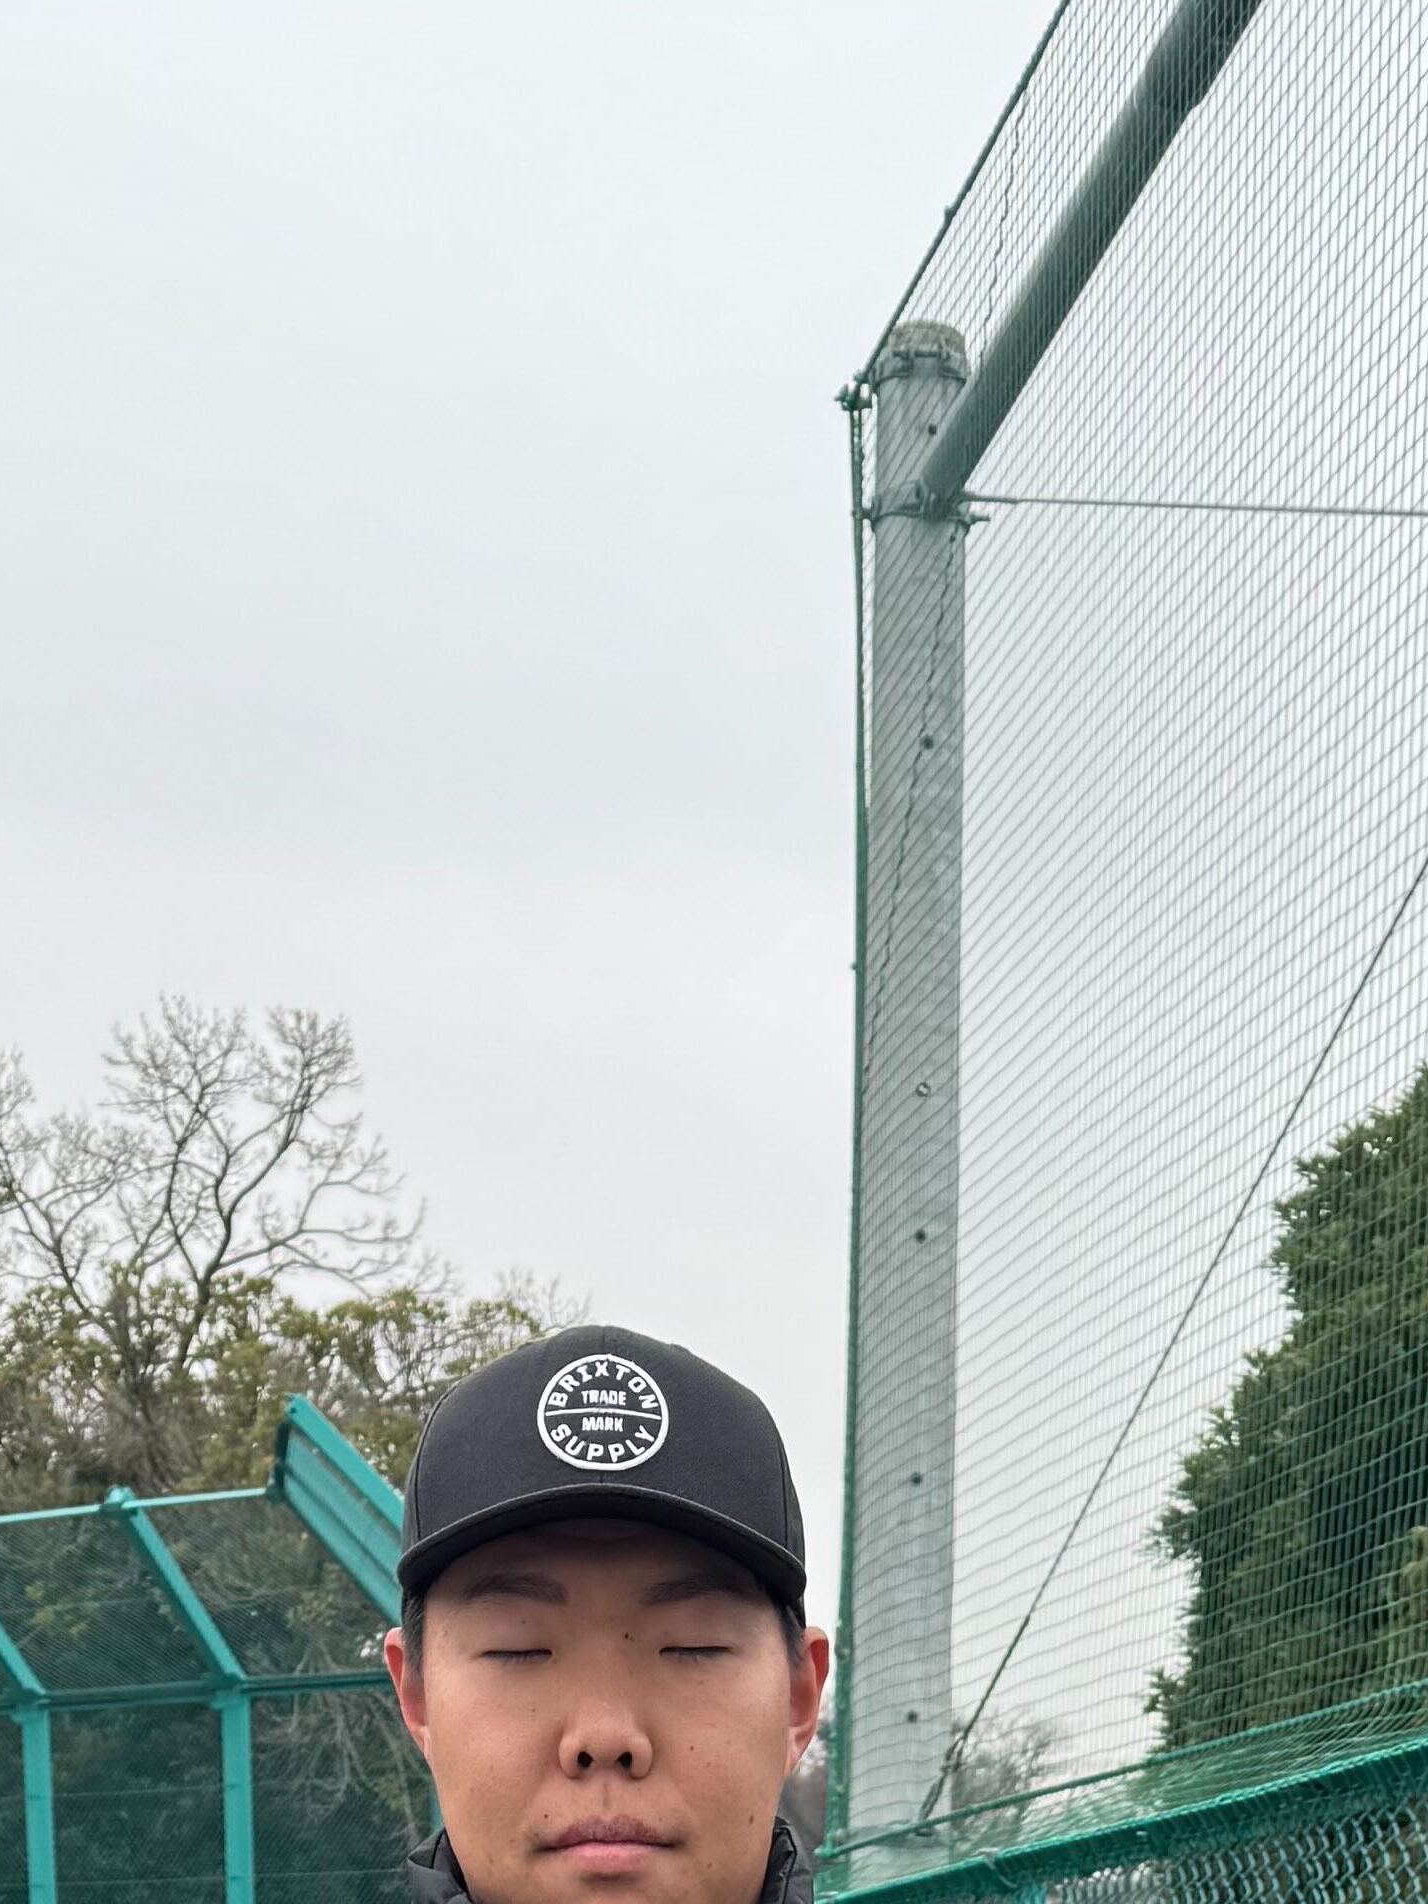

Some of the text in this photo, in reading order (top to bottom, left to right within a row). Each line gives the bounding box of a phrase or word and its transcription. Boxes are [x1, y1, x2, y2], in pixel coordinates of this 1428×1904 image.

[548, 1362, 658, 1409] BRIXTON
[581, 1390, 627, 1406] TRADE
[582, 1417, 624, 1432] MARK
[550, 1424, 655, 1462] SUPPLY
